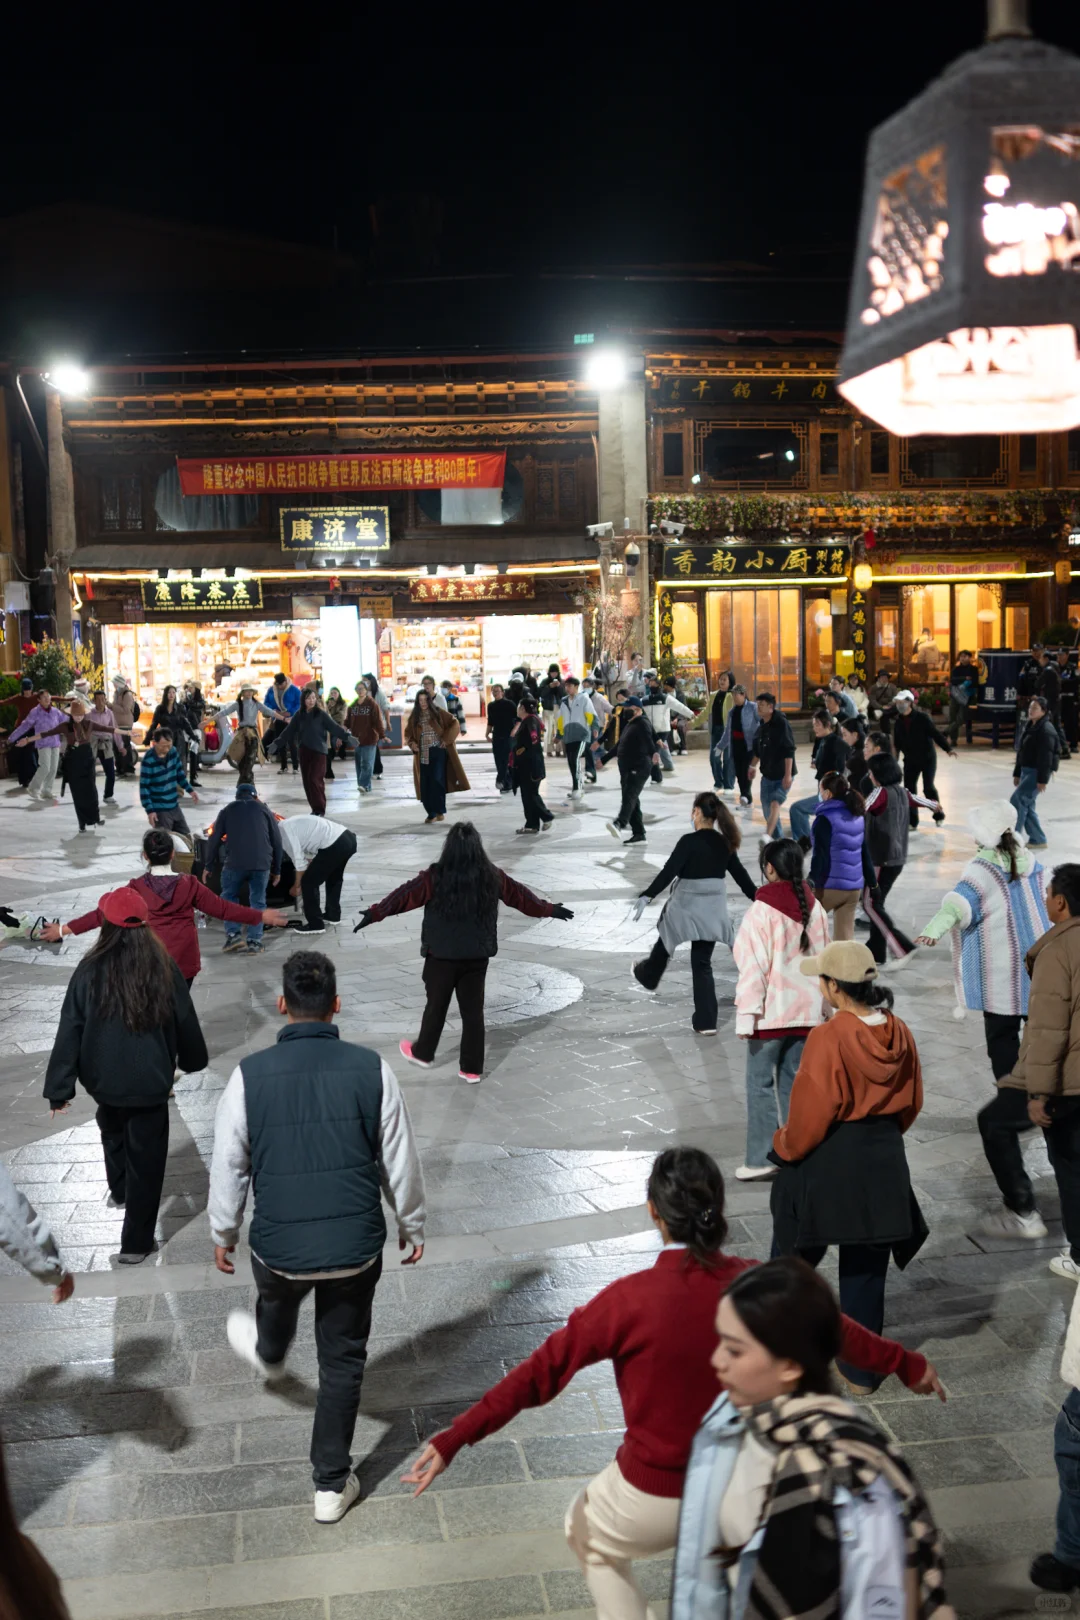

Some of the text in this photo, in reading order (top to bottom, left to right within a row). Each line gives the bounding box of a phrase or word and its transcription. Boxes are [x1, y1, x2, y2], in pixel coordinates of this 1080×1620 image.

[692, 379, 827, 400] 干锅牛肉
[291, 517, 379, 541] 康济堂
[672, 547, 812, 573] 香韵小厨
[155, 581, 250, 600] 康隆茶庄
[416, 582, 529, 598] 康济堂土特产商行
